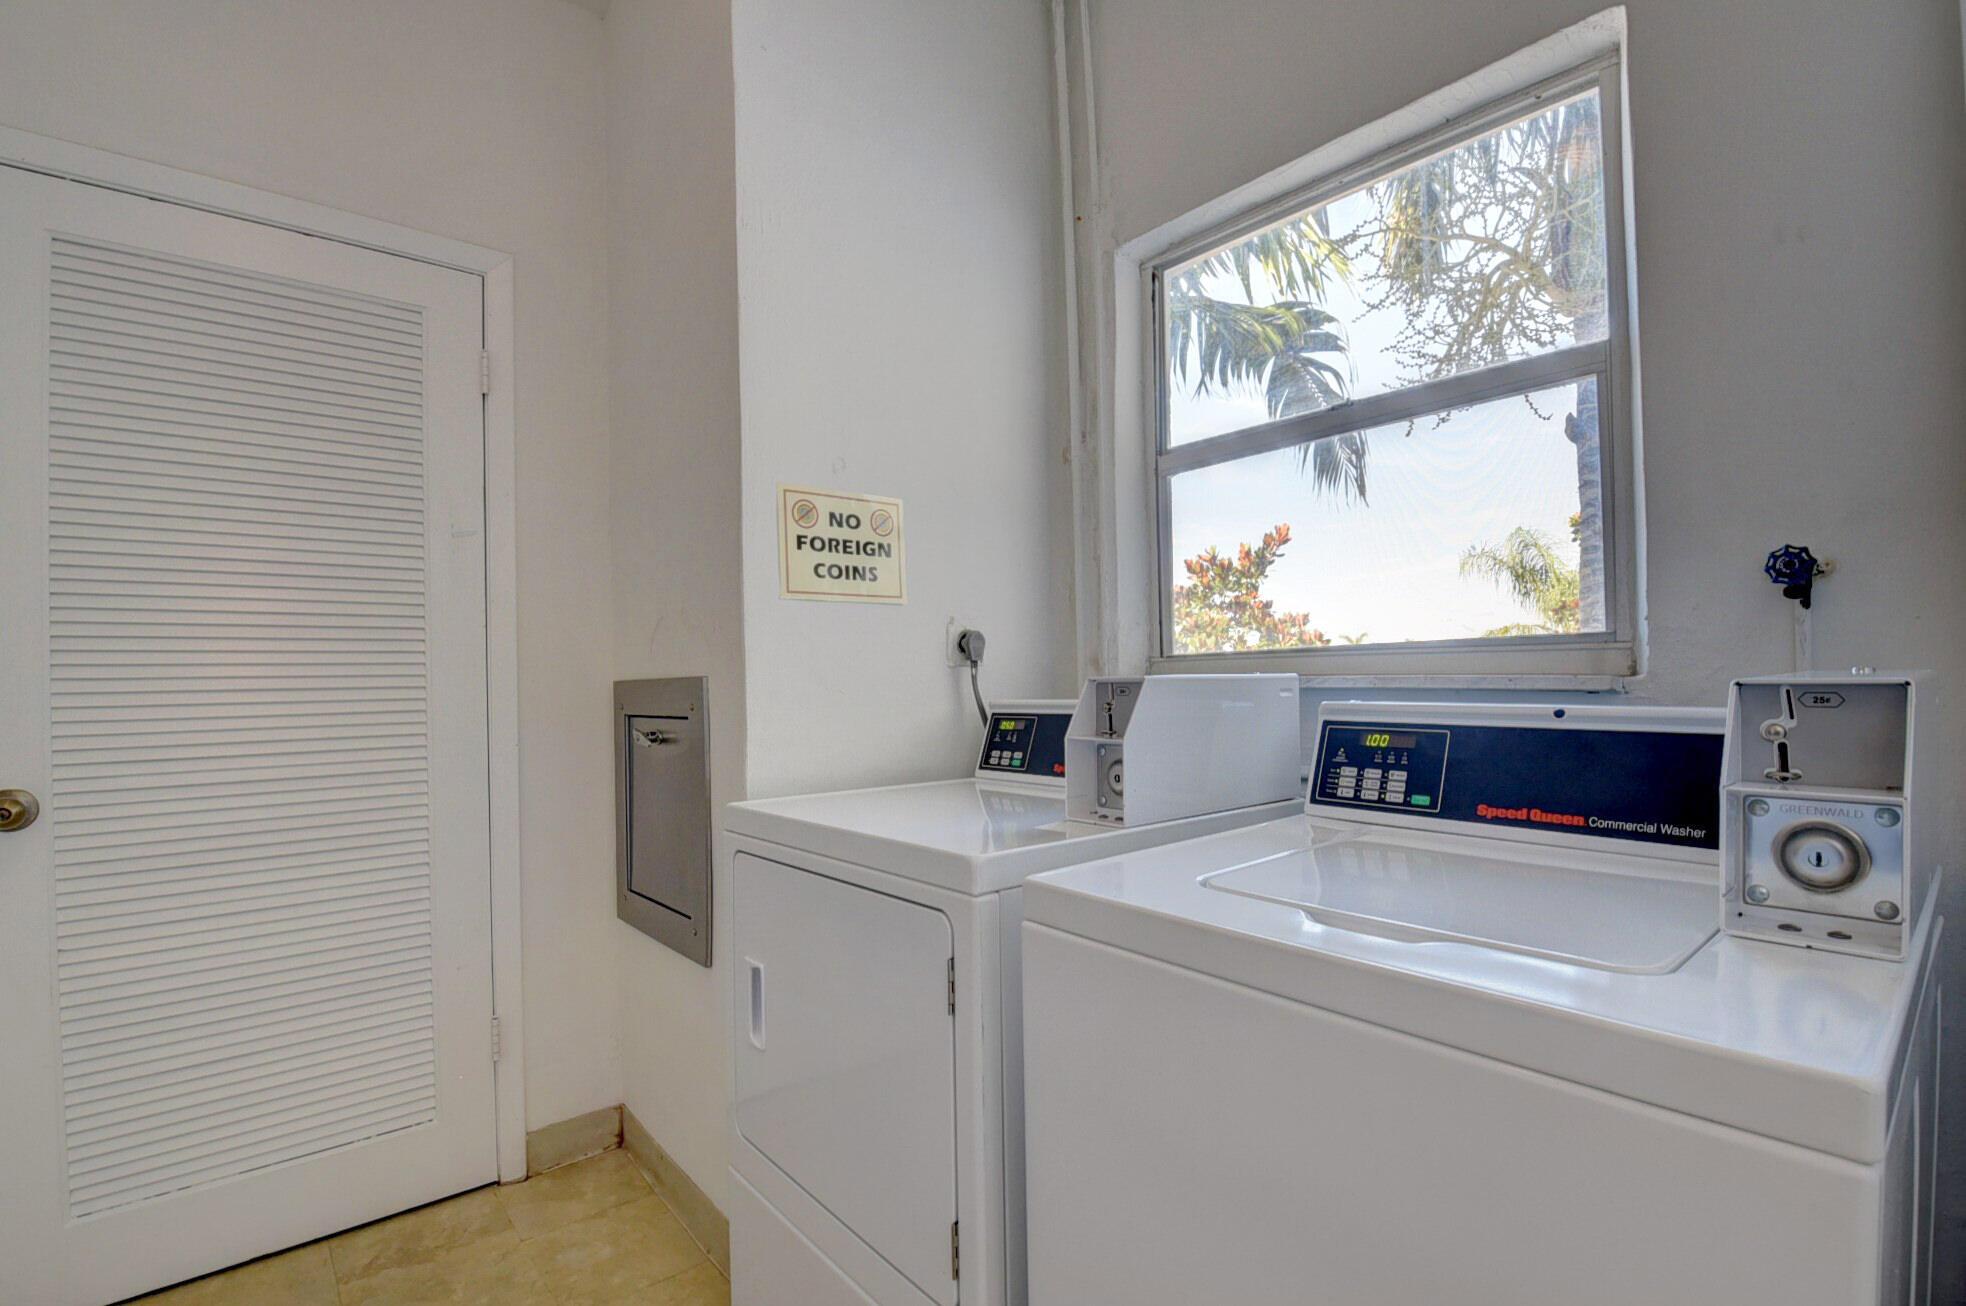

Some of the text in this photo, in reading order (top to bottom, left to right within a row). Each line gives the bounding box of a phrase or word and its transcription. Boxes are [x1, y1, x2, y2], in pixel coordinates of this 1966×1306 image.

[828, 511, 861, 530] NO
[796, 534, 892, 558] FOREIGN
[813, 563, 878, 582] COINS
[1778, 803, 1864, 819] GREENWALD
[1476, 803, 1707, 839] Speed Queen Commercial Washer
